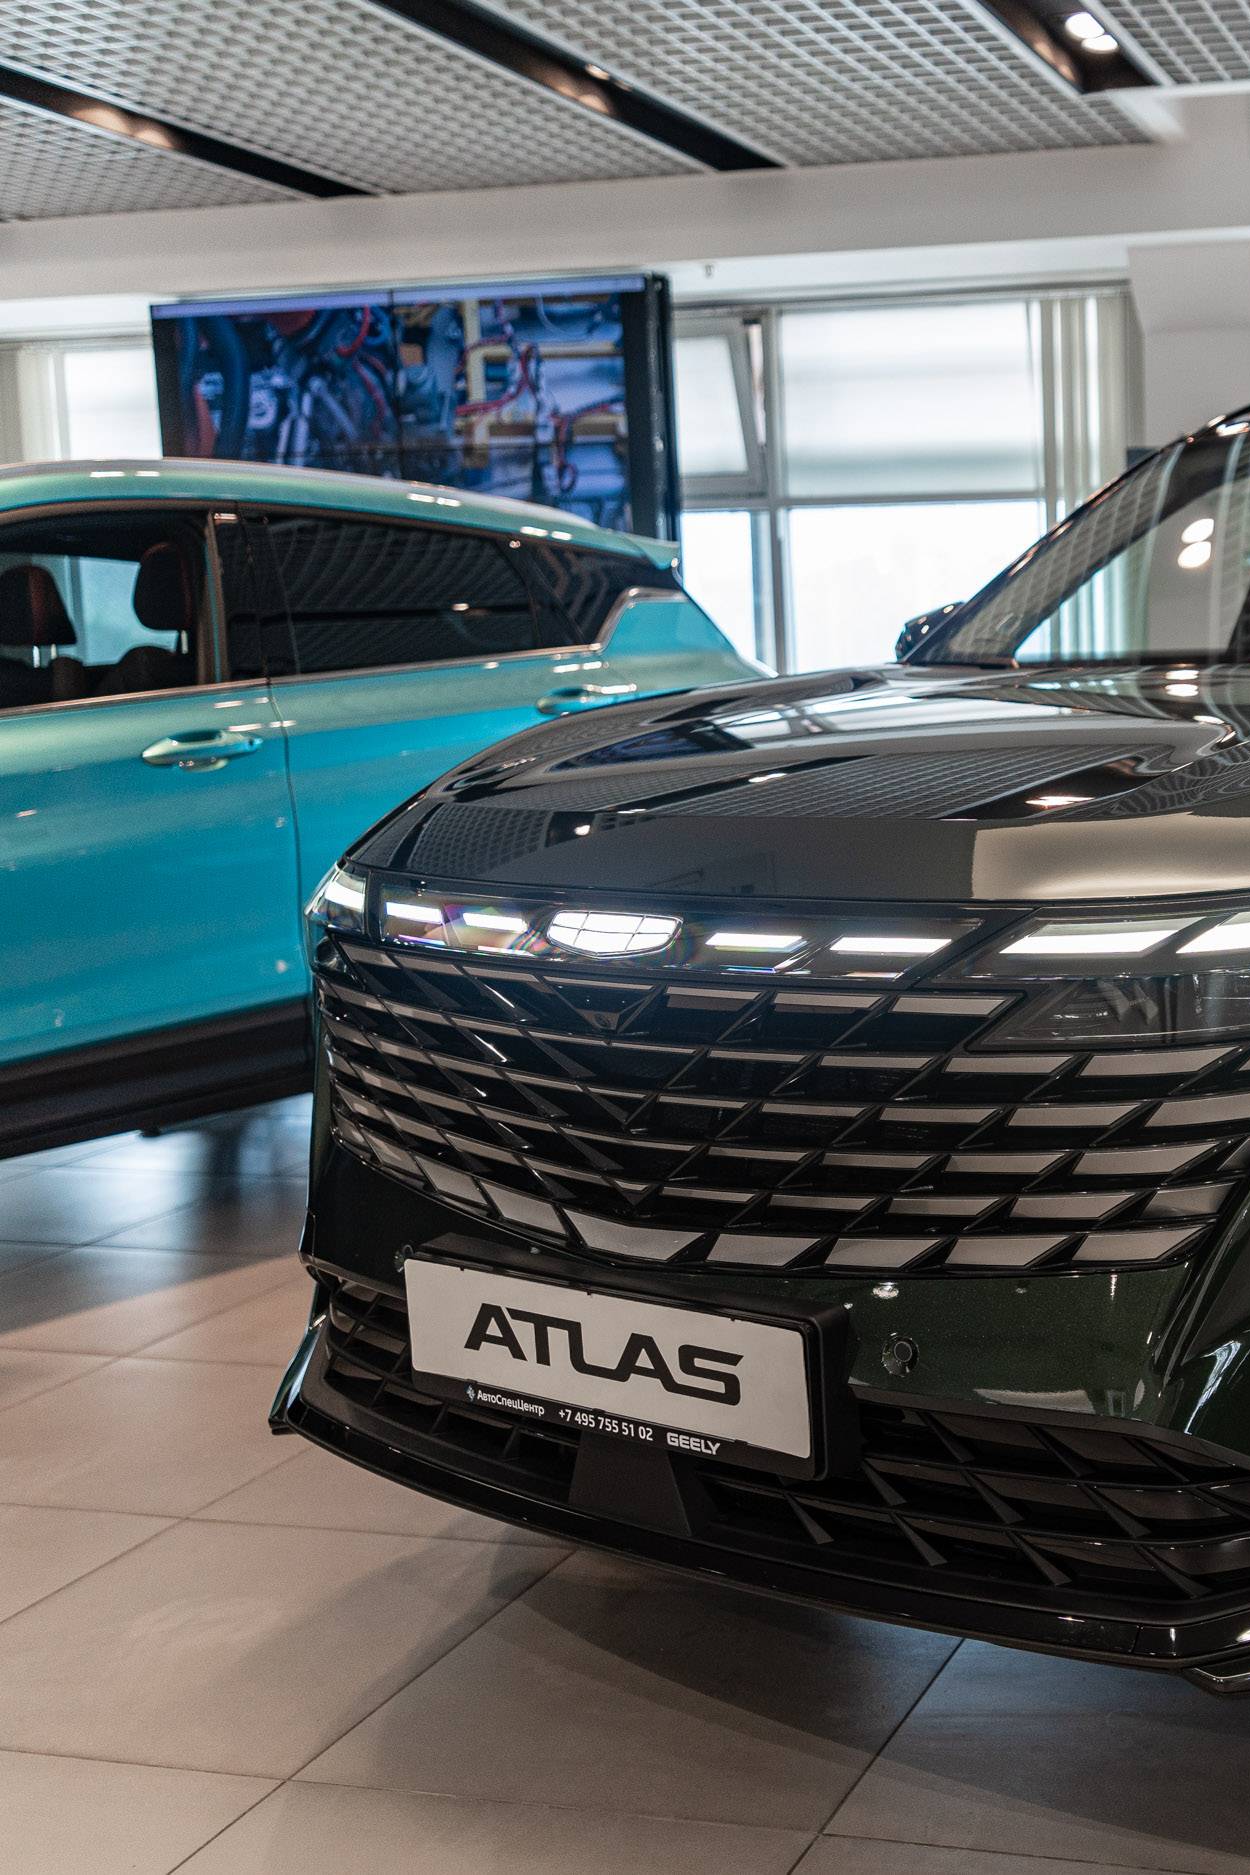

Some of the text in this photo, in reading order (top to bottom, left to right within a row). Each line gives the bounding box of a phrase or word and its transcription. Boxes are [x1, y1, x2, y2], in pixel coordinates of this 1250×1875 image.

[464, 1303, 744, 1406] ATLAS
[477, 1389, 545, 1416] АвтоСпецЦентр
[558, 1408, 654, 1441] +7 495 755 51 02
[666, 1431, 721, 1456] GEELY
